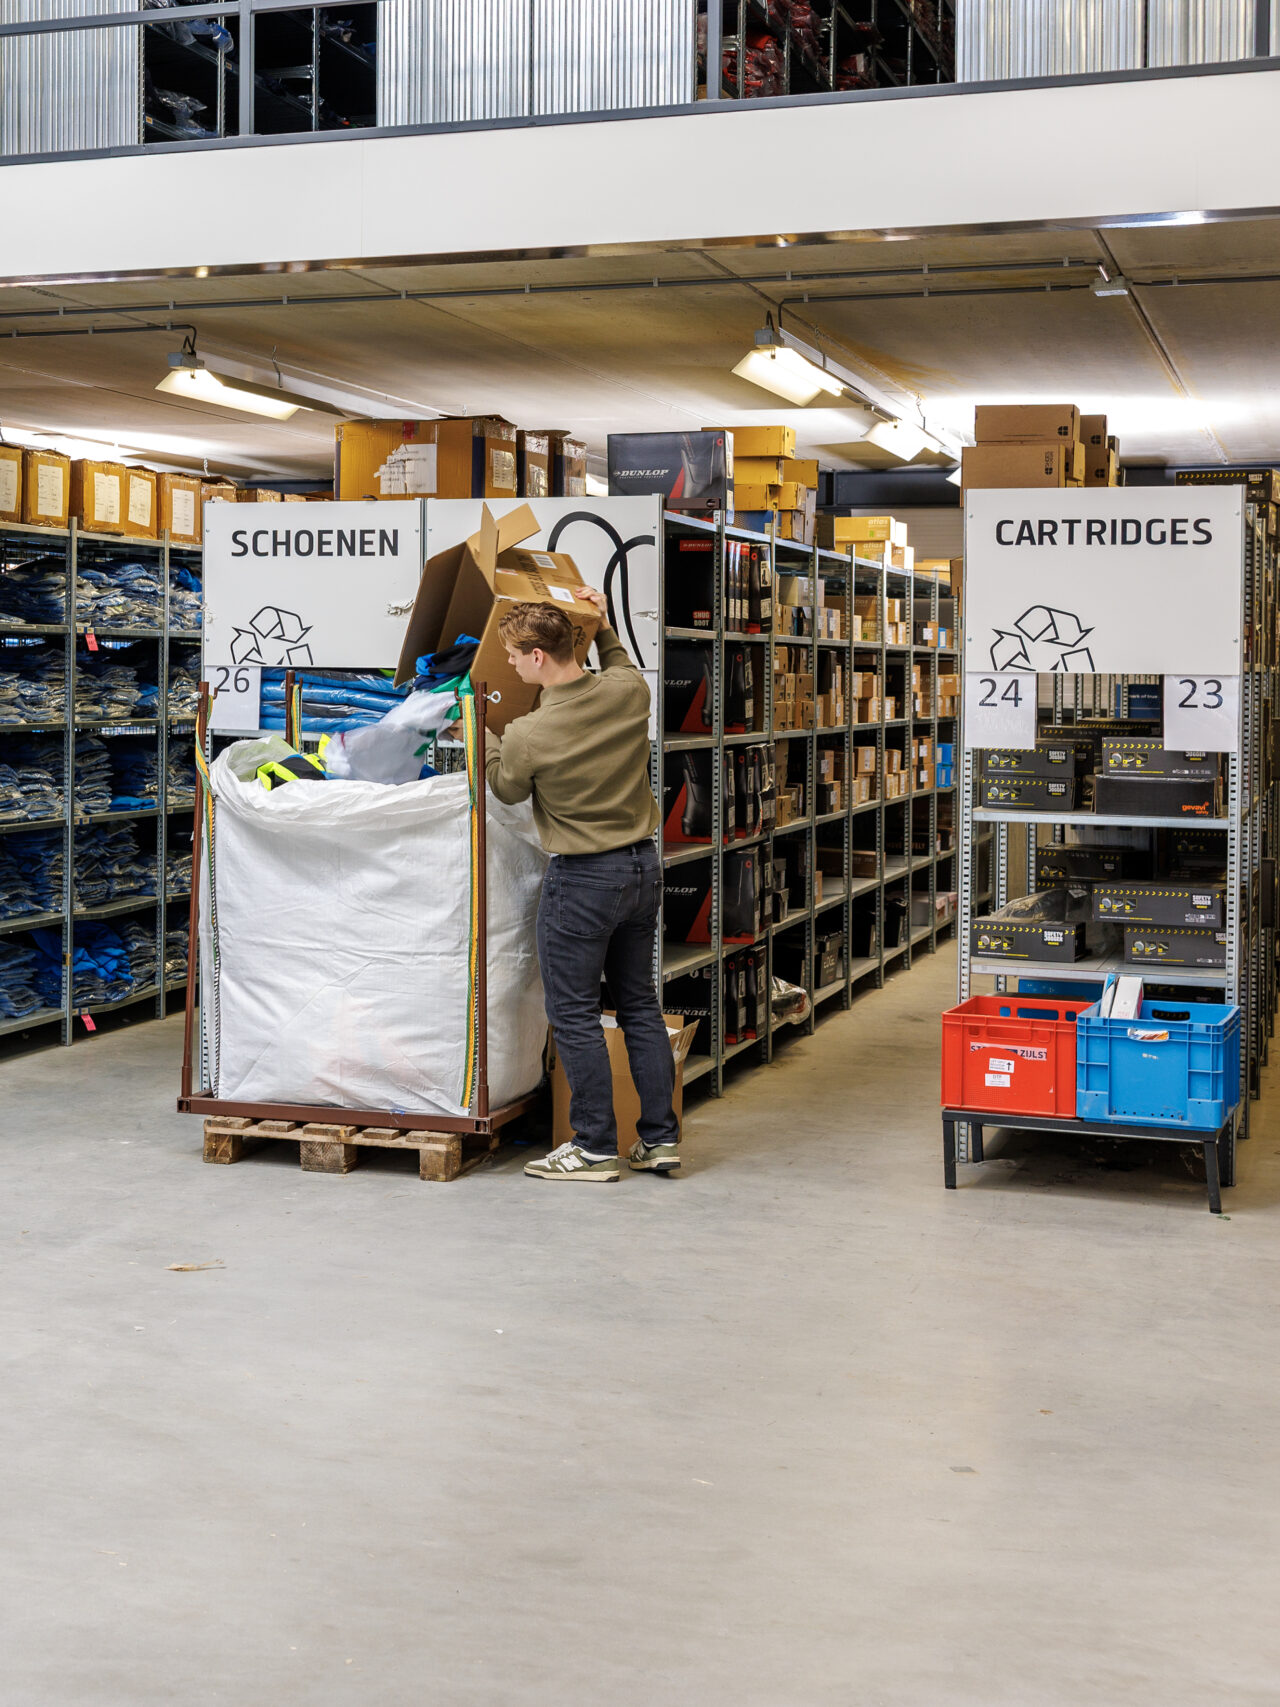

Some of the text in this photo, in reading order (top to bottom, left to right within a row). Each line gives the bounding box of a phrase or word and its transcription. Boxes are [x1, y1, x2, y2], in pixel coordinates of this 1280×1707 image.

[232, 529, 399, 557] SCHOENEN
[996, 518, 1213, 546] CARTRIDGES
[217, 667, 250, 693] 26
[979, 679, 1023, 708] 24
[1178, 679, 1223, 709] 23
